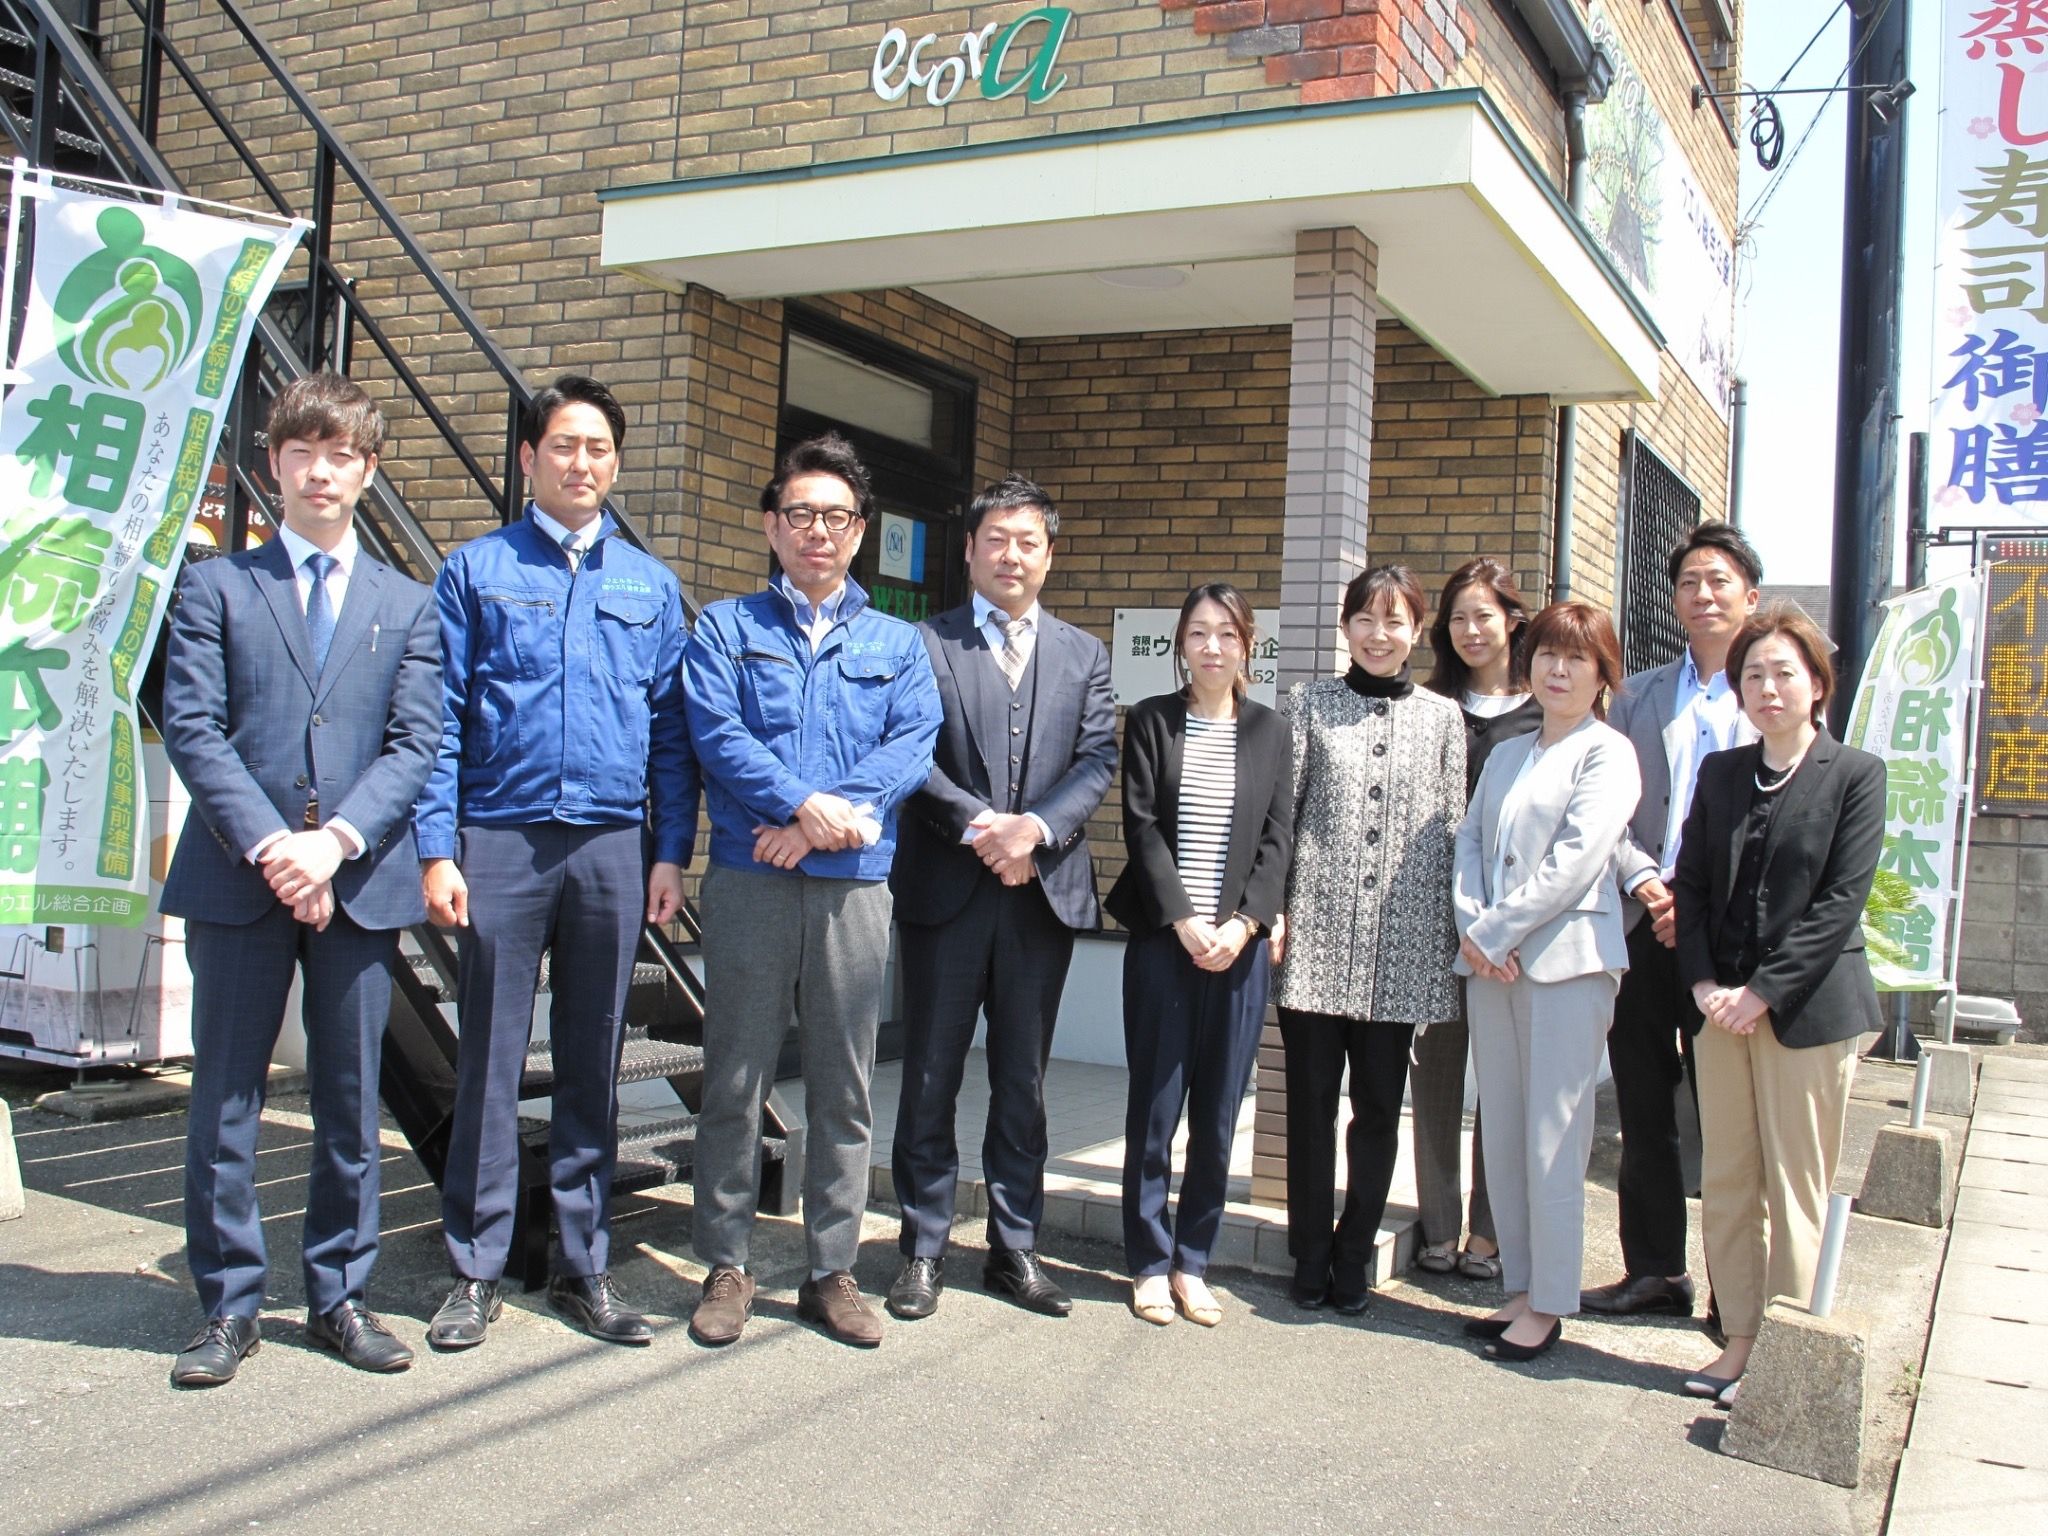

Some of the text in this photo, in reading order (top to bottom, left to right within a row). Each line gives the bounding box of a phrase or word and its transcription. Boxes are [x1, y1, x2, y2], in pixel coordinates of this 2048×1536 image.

[873, 7, 1073, 106] ecora
[201, 243, 269, 393] 相続の手続き
[1941, 0, 2048, 504] 蒸し寿司御膳
[150, 412, 208, 565] 相続税の節税
[0, 893, 132, 915] ウエル総合企画
